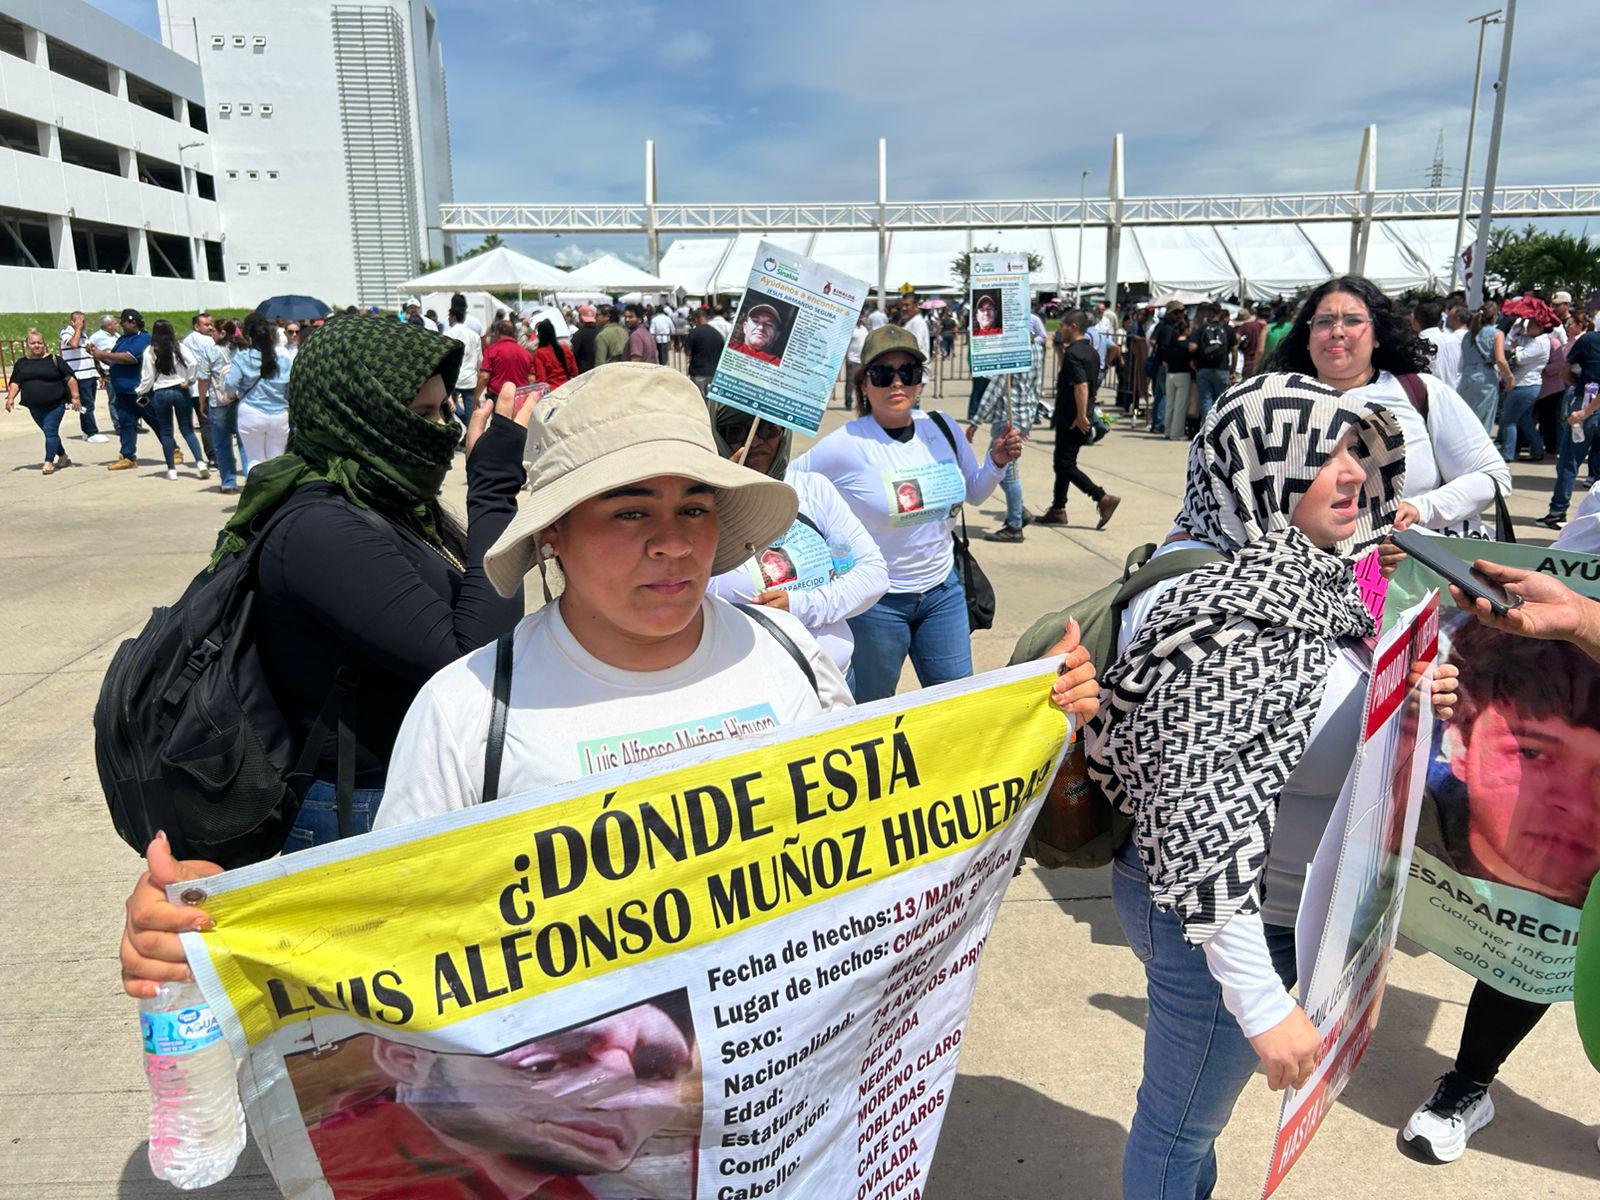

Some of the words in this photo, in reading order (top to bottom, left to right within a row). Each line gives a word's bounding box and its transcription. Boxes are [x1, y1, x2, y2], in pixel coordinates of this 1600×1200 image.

[814, 307, 837, 320] SEGURA
[779, 576, 825, 591] APARECIDO
[499, 771, 774, 926] ¿DÓNDE
[787, 714, 921, 824] ESTÁ
[266, 969, 414, 1025] LUIS
[434, 887, 692, 1015] ALFONSO
[706, 825, 872, 929] MUÑOZ
[1408, 862, 1579, 947] ESAPARECI
[1428, 895, 1513, 947] Cualquier
[707, 955, 777, 992] Fecha
[781, 939, 808, 964] de
[812, 908, 891, 953] hechos:
[713, 990, 780, 1029] Lugar
[785, 976, 812, 1001] de
[816, 941, 890, 989] hechos:
[1453, 945, 1489, 969] solo
[1492, 968, 1505, 979] a
[1482, 941, 1507, 960] No
[185, 1016, 218, 1035] AGUA
[720, 1026, 783, 1065] Sexo:
[724, 1012, 855, 1098] Nacionalidad:
[719, 1098, 831, 1176] Complexión:
[860, 1011, 920, 1076] DELGADA
[723, 1087, 784, 1126] Edad:
[857, 1063, 914, 1128] MORENO
[916, 1028, 962, 1073] CLARO
[717, 1155, 801, 1200] Cabello:
[858, 1048, 903, 1101] NEGRO
[721, 1093, 809, 1148] Estatura:
[857, 1079, 926, 1154] POBLADAS
[858, 1131, 889, 1178] CAFÉ
[892, 1088, 945, 1143] CLAROS
[857, 1137, 919, 1200] OVALADA
